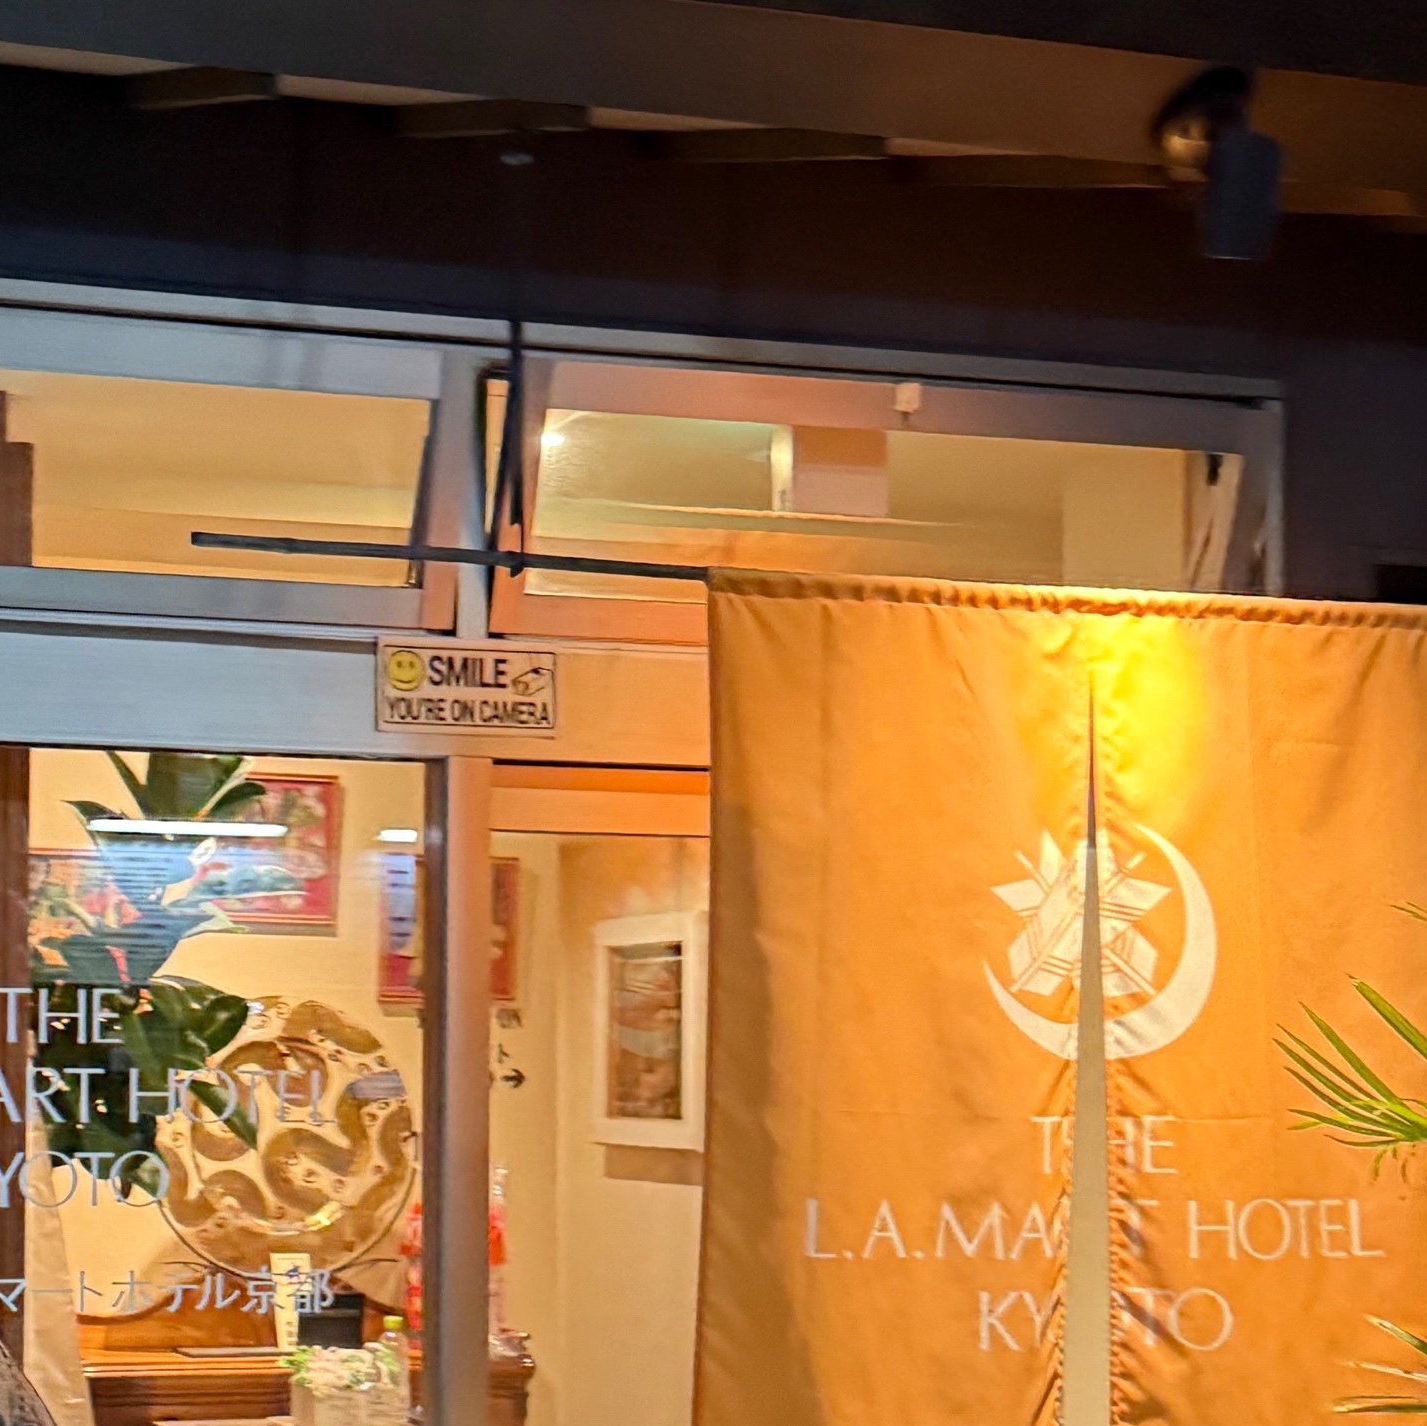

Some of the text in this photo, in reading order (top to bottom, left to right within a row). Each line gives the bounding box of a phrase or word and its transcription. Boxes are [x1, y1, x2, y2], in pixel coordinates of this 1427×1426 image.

[429, 655, 508, 689] SMILE
[451, 699, 474, 722] ON
[479, 700, 551, 725] CAMERA
[128, 1067, 338, 1125] HOTEL
[1030, 1115, 1178, 1174] THE
[1187, 1198, 1386, 1260] HOTEL
[978, 1288, 1235, 1351] KYTO
